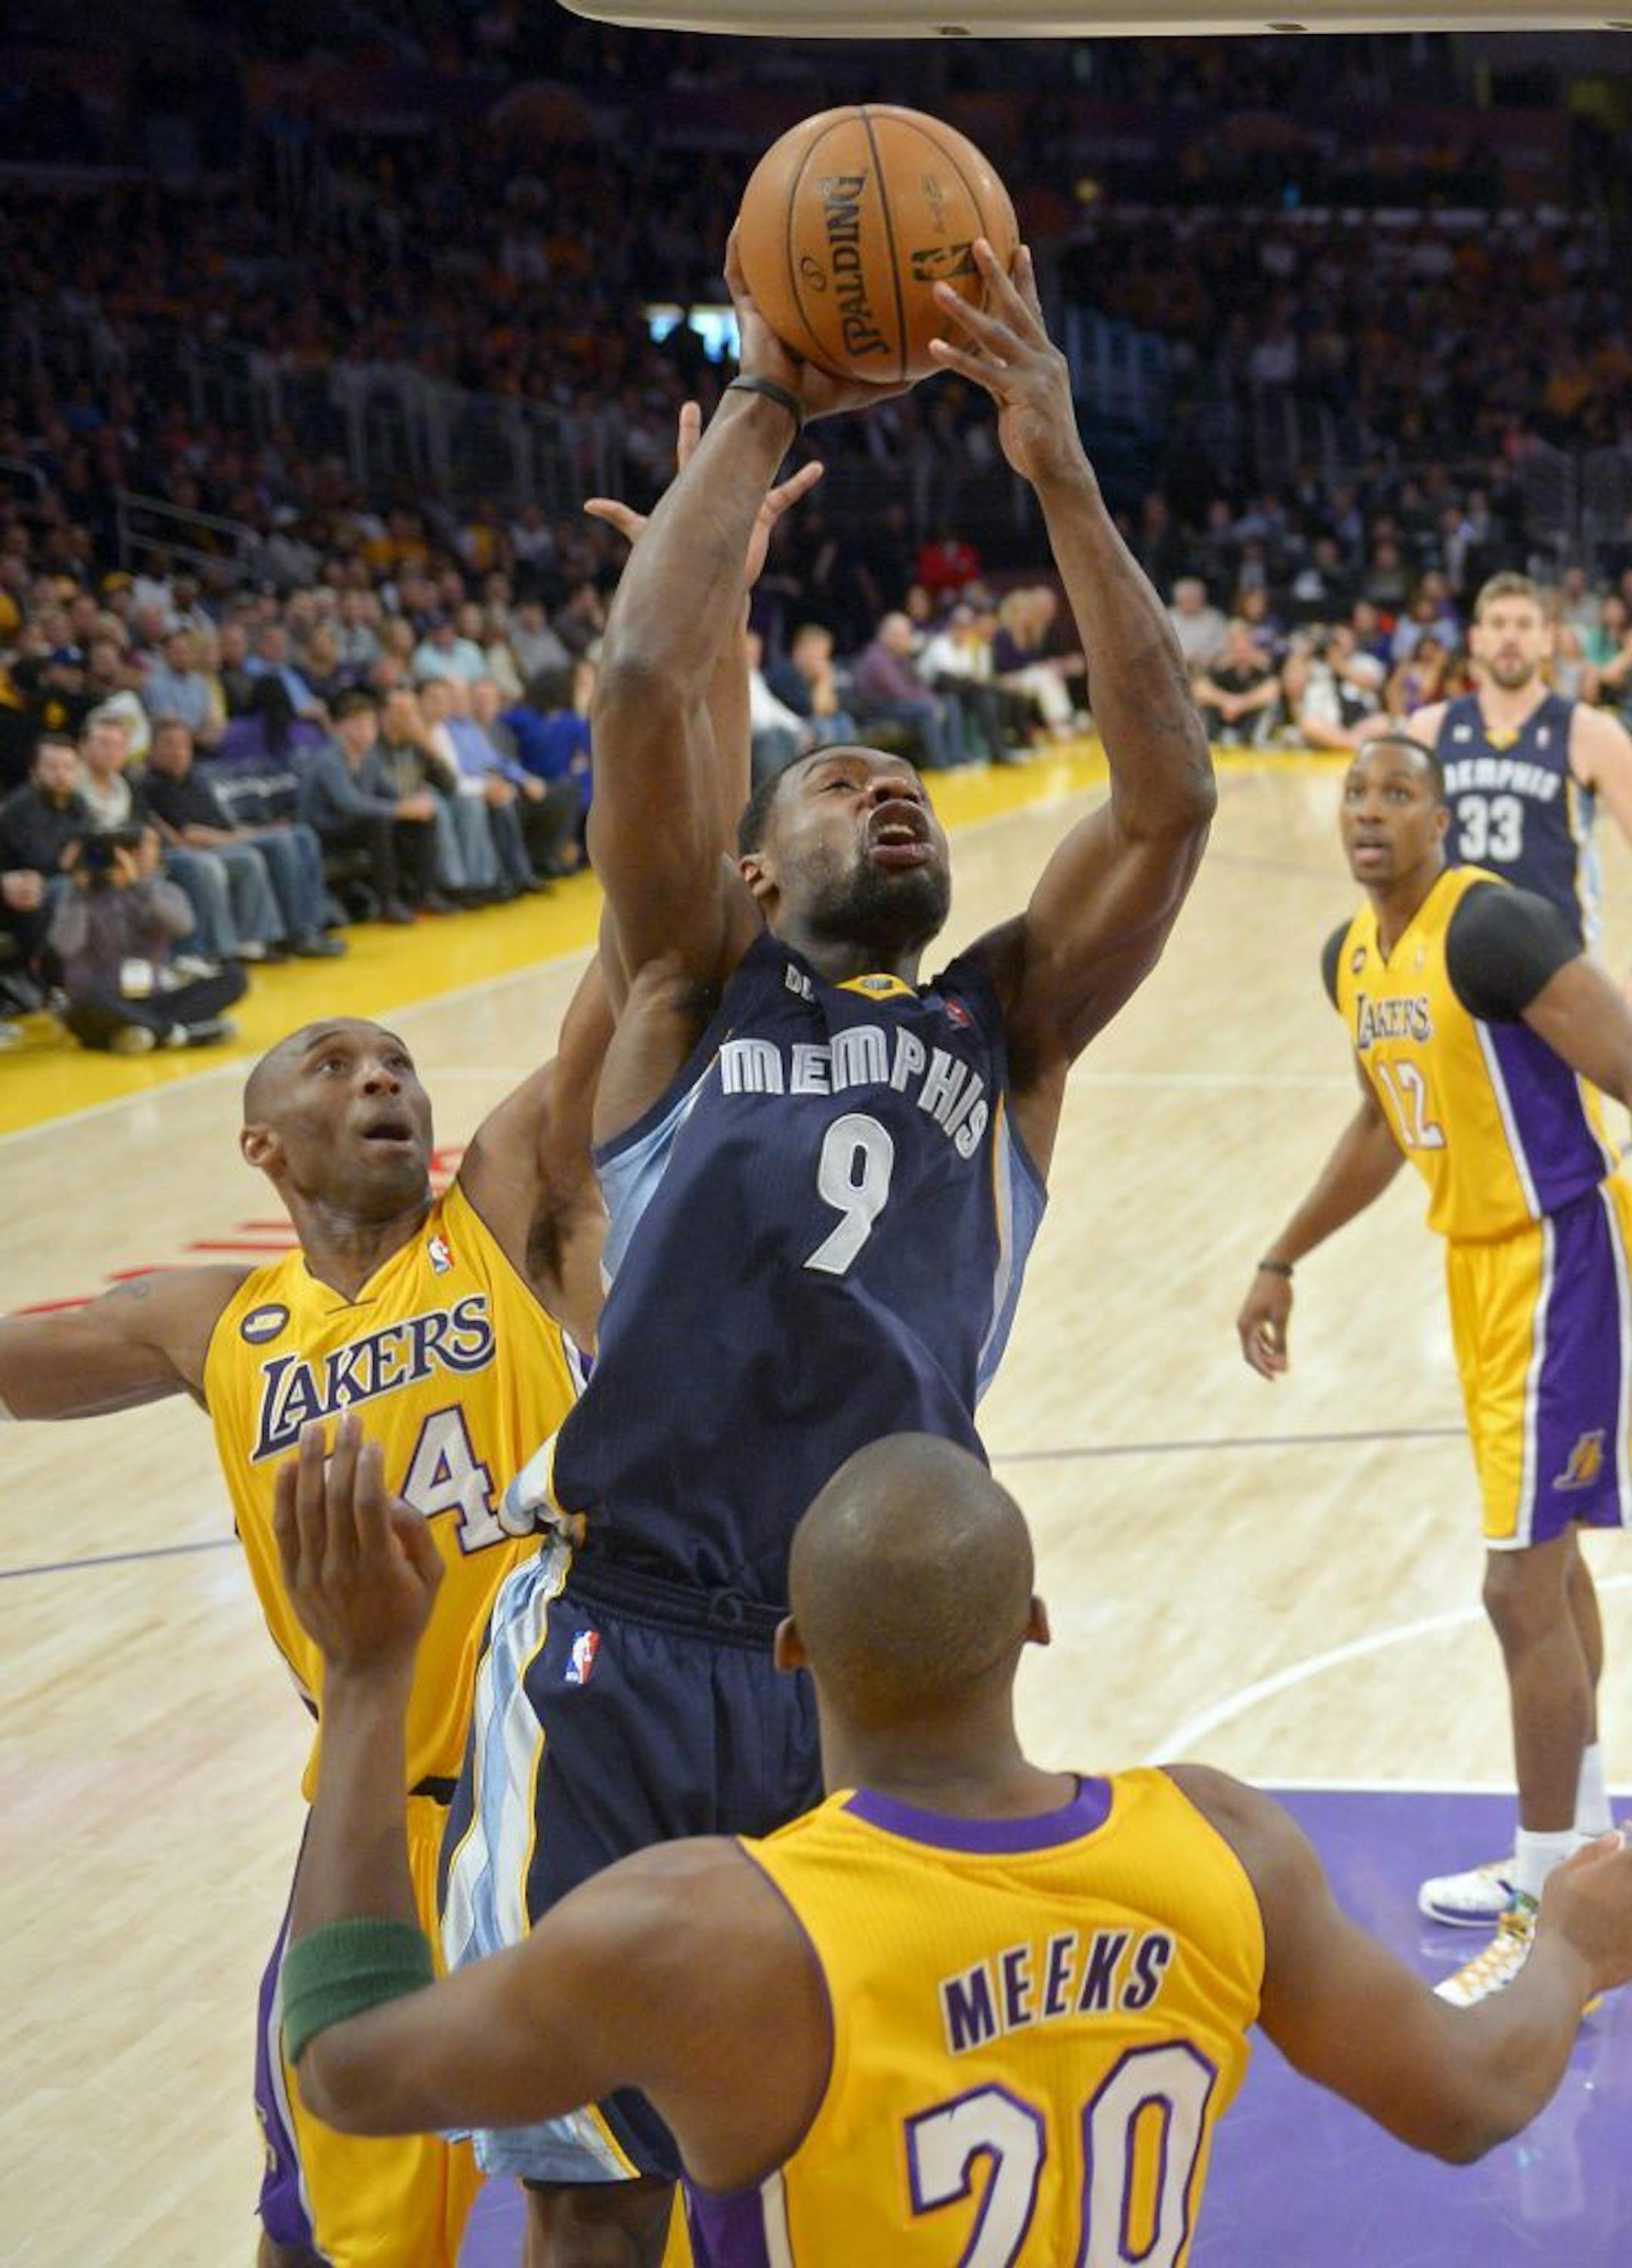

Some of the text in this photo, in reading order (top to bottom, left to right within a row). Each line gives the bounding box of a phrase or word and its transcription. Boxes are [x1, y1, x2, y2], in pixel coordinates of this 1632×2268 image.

[818, 173, 890, 357] SPALDING
[1457, 794, 1523, 862] 33
[1355, 993, 1431, 1049] LAKERS
[719, 1023, 989, 1159] MEMPHIS
[1377, 1060, 1448, 1149] 12
[803, 1112, 894, 1275] 9
[249, 1295, 496, 1463] LAKERS
[939, 1929, 1176, 2056] MEEKS
[904, 2039, 1219, 2268] 20
